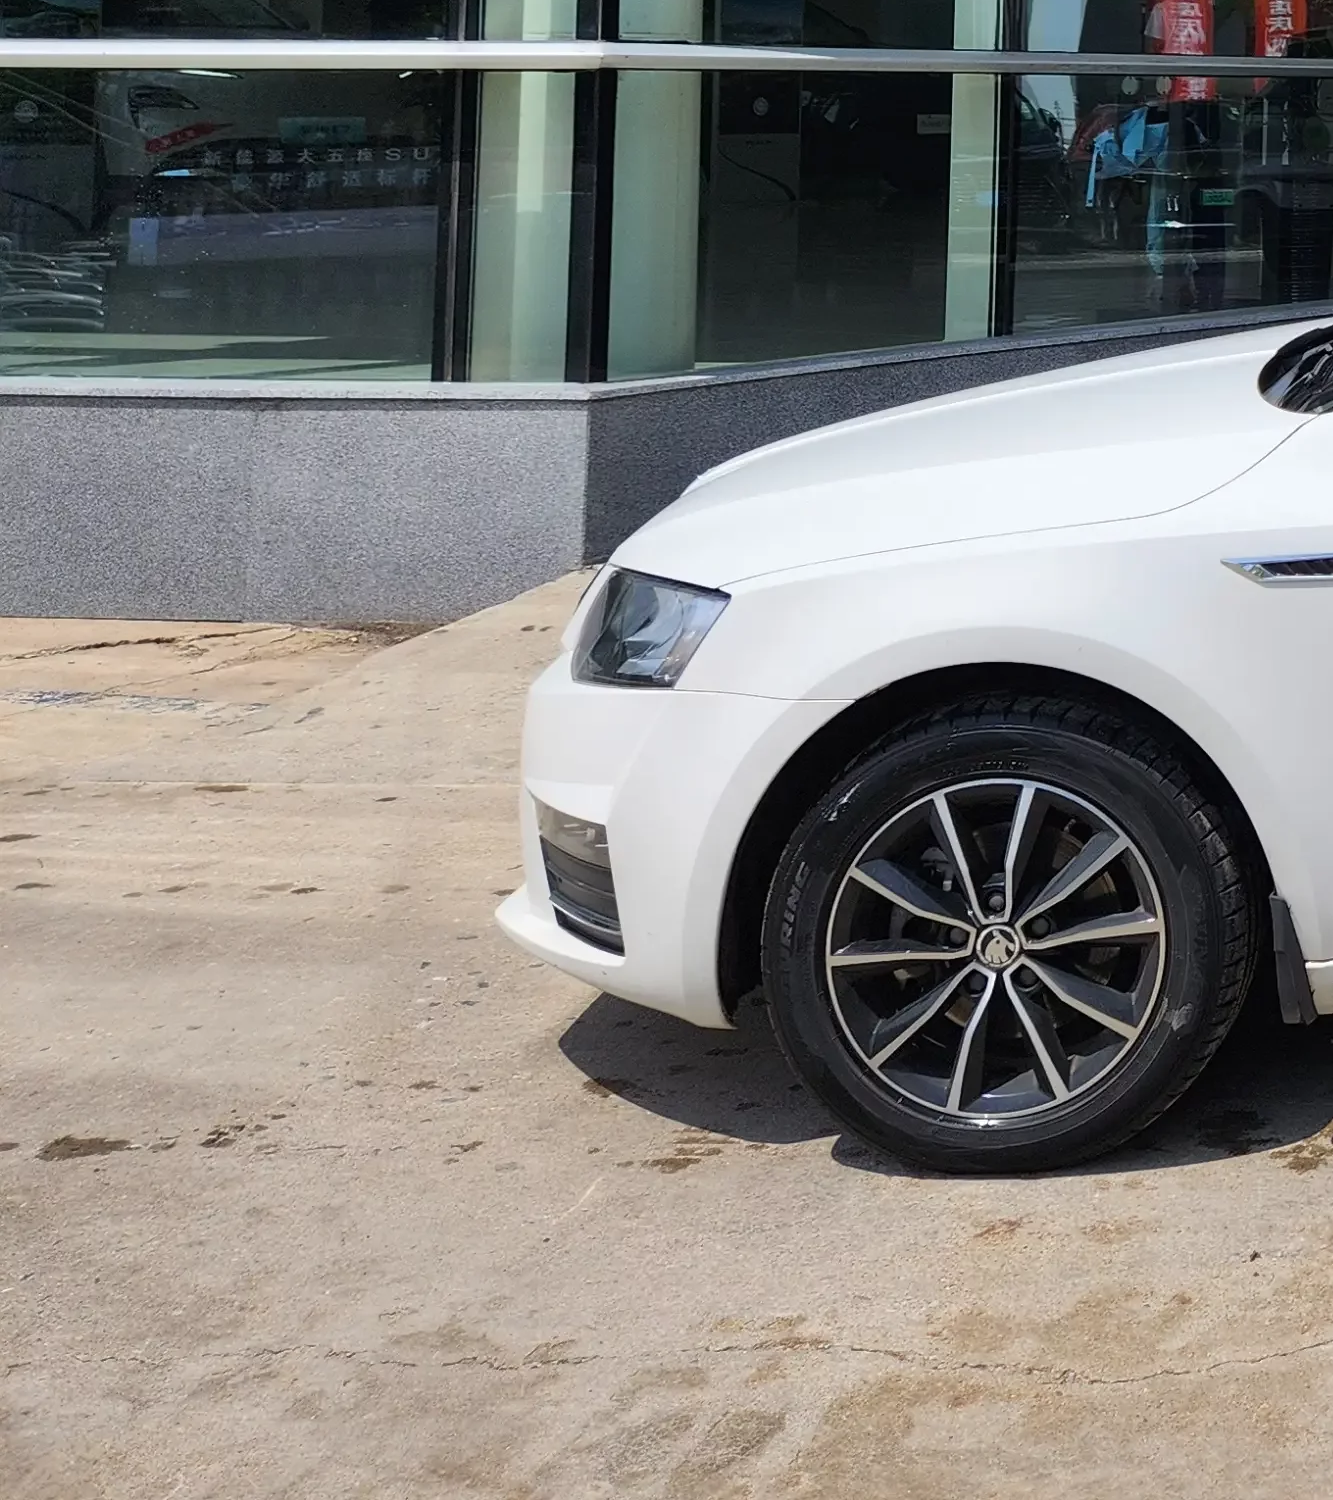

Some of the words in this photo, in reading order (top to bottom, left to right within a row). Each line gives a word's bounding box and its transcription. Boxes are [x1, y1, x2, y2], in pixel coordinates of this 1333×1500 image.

[202, 147, 441, 165] 新能源大五座SU
